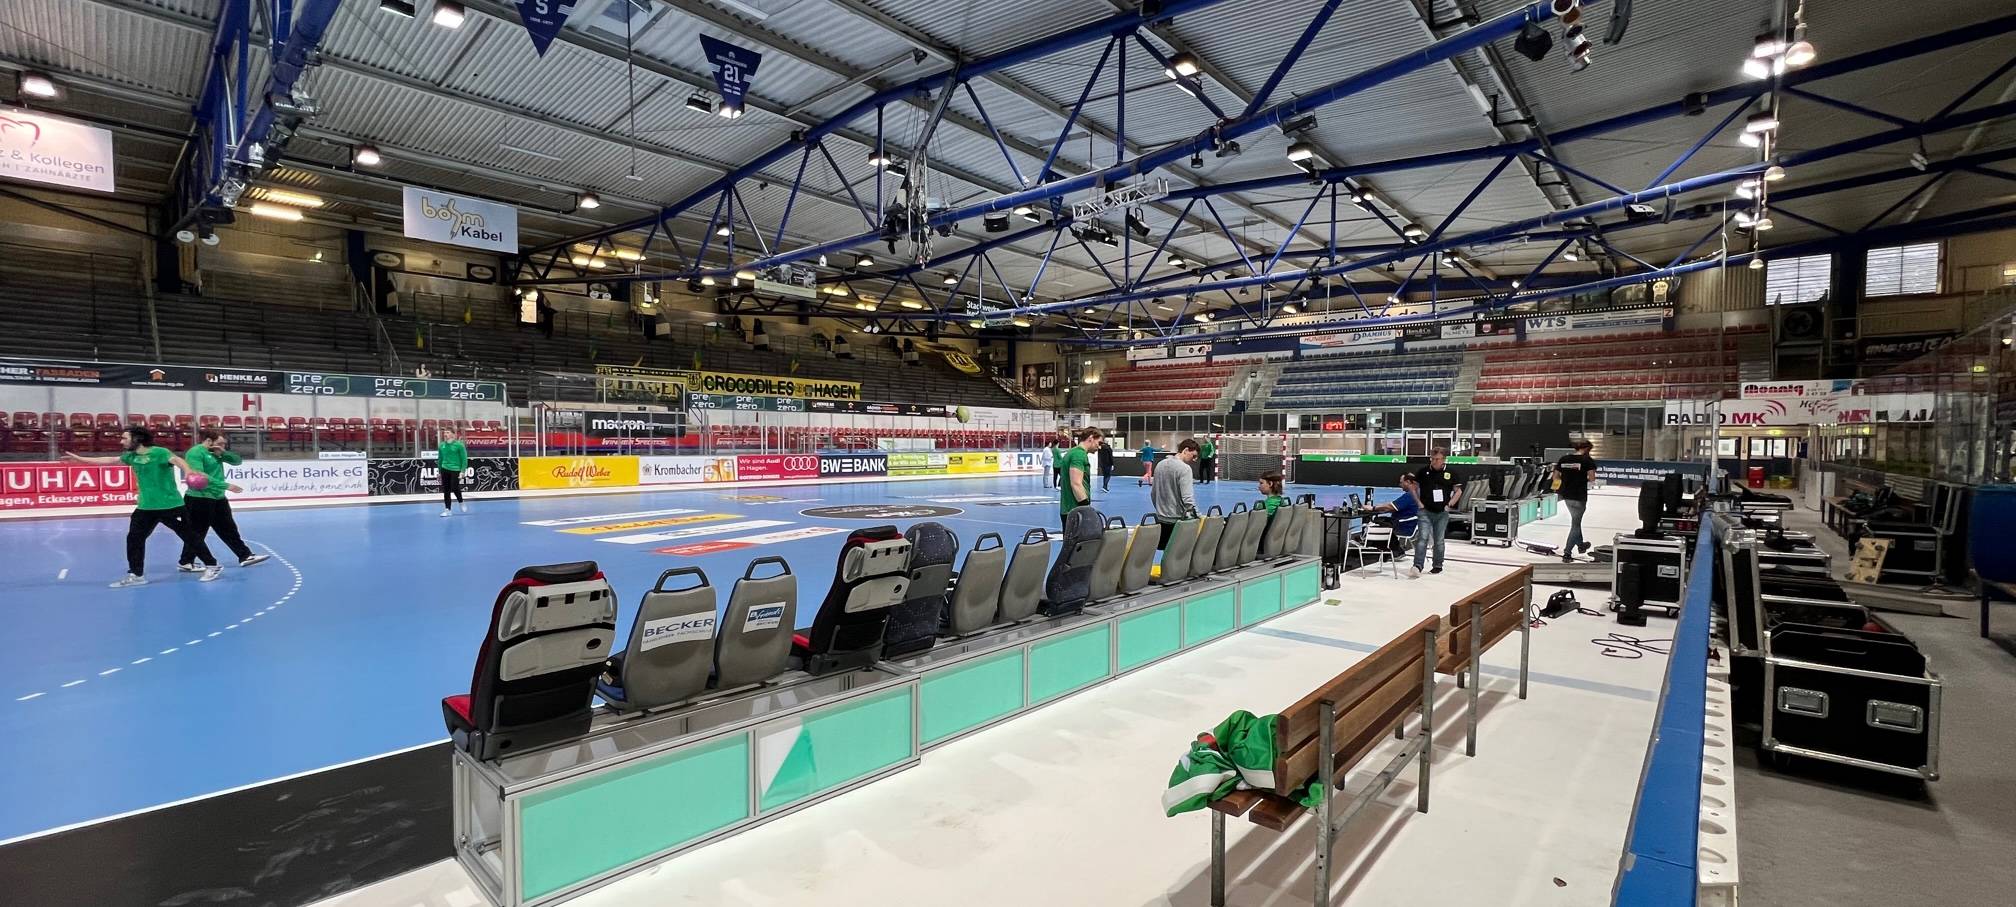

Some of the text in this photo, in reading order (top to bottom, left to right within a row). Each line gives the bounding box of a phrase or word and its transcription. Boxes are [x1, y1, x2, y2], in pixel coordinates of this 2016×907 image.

[724, 64, 740, 84] 21
[11, 150, 23, 161] &
[30, 153, 105, 174] Kollegen
[461, 226, 503, 243] Kabel
[1527, 316, 1567, 329] WTS
[219, 373, 253, 382] HENKE
[290, 374, 322, 385] pre
[375, 378, 404, 388] pre
[290, 385, 335, 395] zero
[450, 381, 476, 391] pre
[703, 375, 856, 399] CROCODILES HAGEN
[375, 388, 414, 397] zero
[450, 391, 485, 400] zero
[691, 393, 709, 401] pre
[736, 395, 752, 403] pre
[691, 401, 716, 409] zero
[777, 404, 797, 412] zero
[1732, 412, 1766, 424] MK
[592, 419, 646, 430] macron
[654, 463, 701, 476] Krombacher
[855, 458, 886, 472] BANK
[224, 466, 363, 480] Märkische Bank eG
[552, 465, 611, 482] Rudolf Weber
[38, 493, 100, 506] Eckeseyer
[644, 618, 714, 638] BECKER
